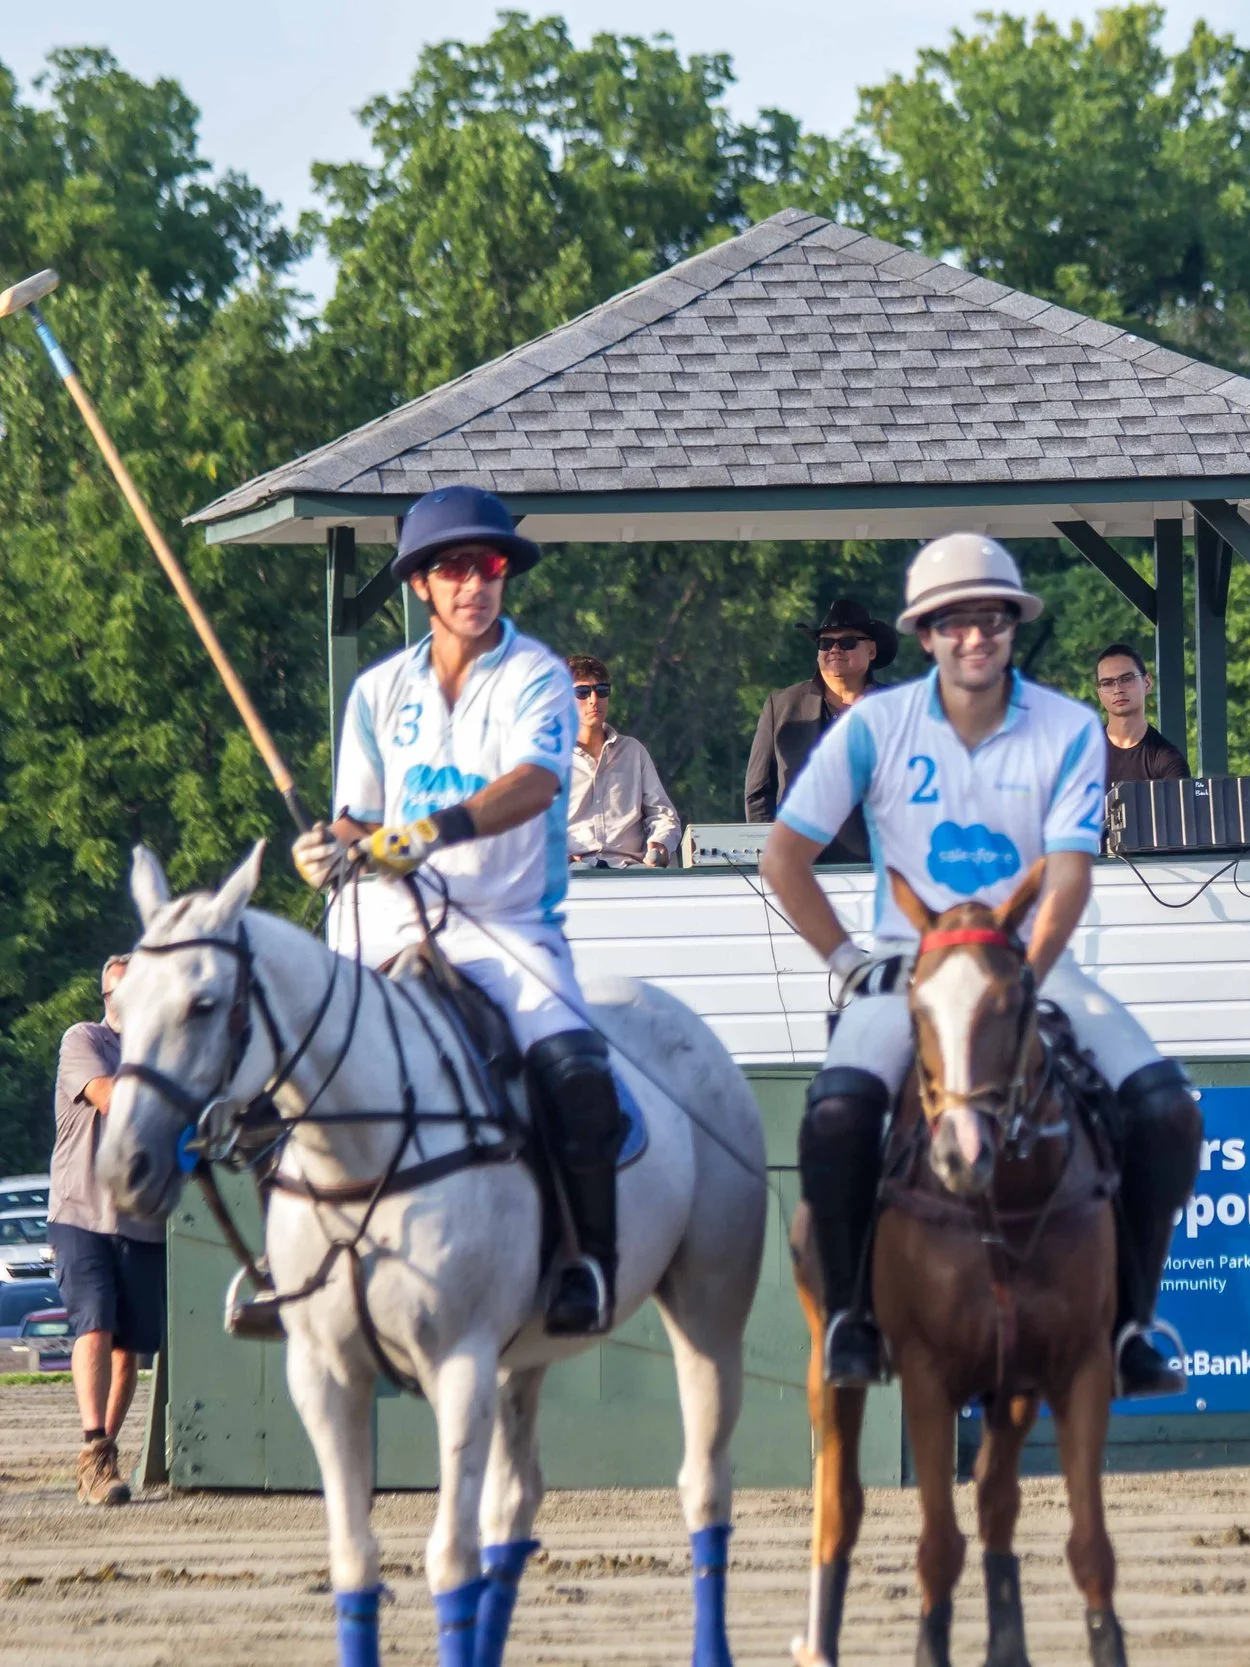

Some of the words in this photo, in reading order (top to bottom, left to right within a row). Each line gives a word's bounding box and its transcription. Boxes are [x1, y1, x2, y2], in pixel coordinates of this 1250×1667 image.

[392, 703, 423, 747] 3
[908, 755, 940, 804] 2
[1078, 782, 1102, 832] 2
